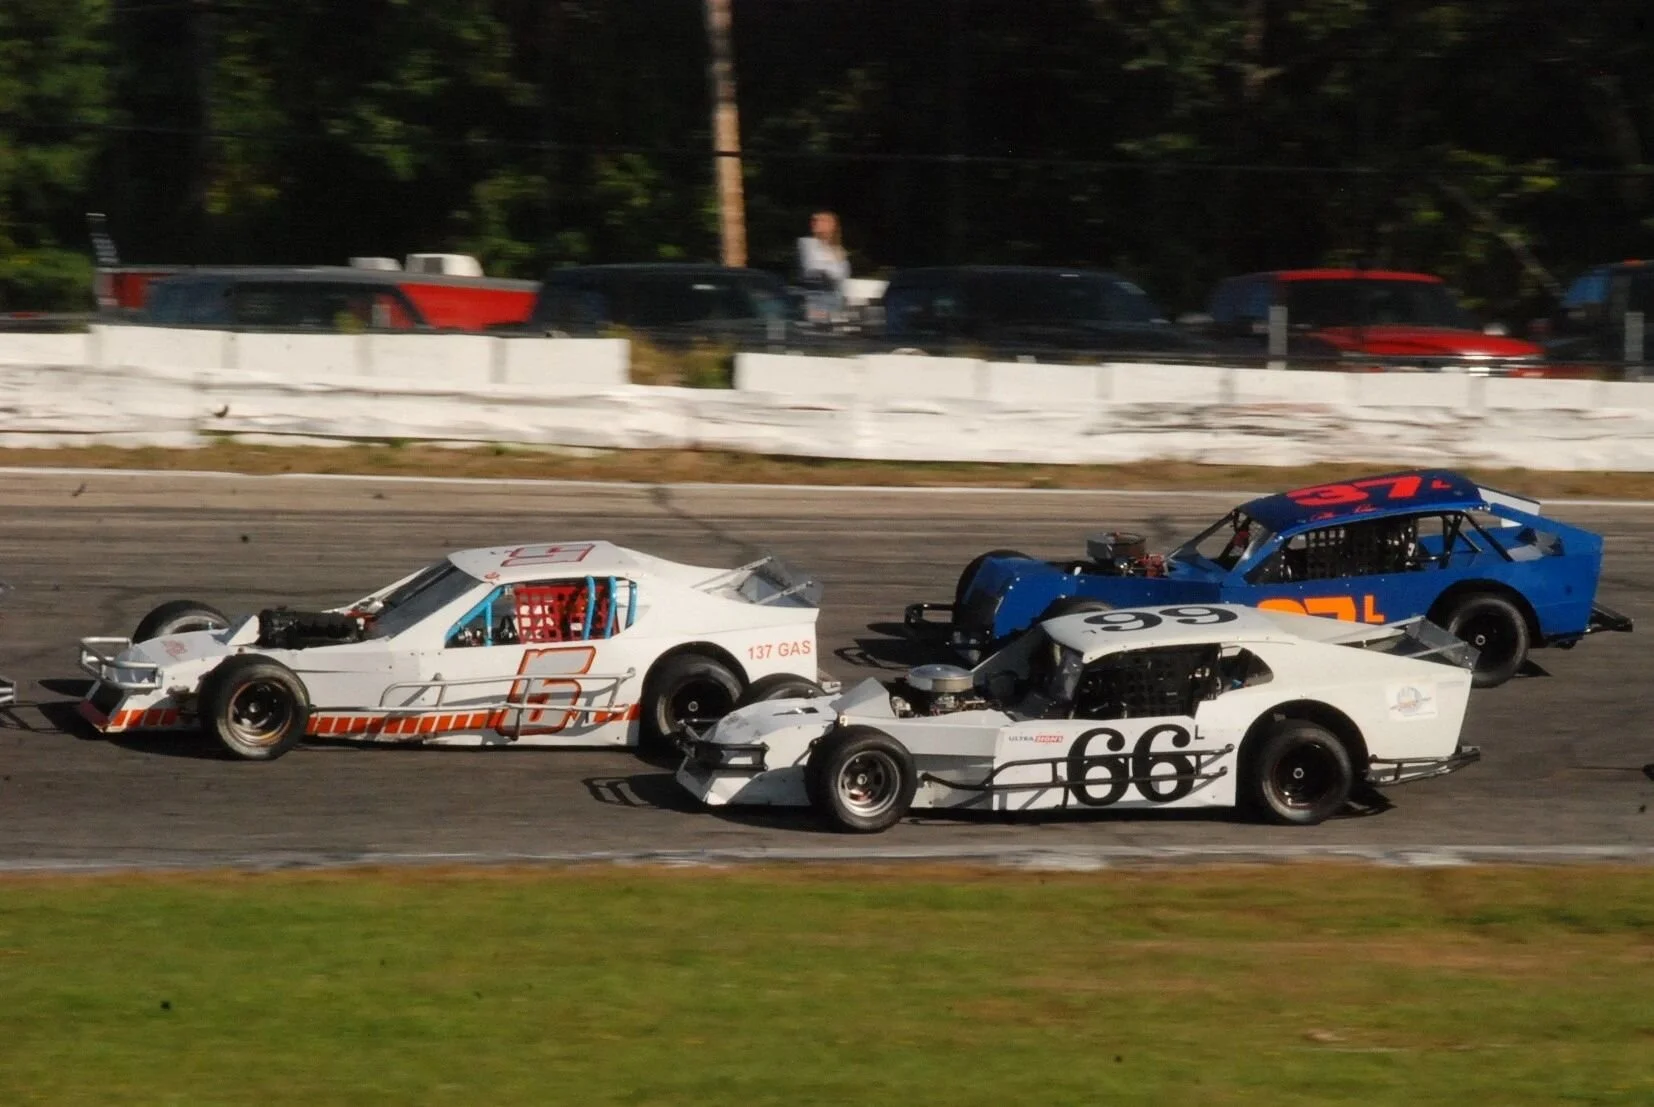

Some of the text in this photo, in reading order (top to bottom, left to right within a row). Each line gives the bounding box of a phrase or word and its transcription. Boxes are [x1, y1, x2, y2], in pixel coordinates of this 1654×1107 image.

[495, 646, 597, 736] 6
[748, 640, 811, 660] 137 GAS
[1066, 723, 1196, 807] 66
